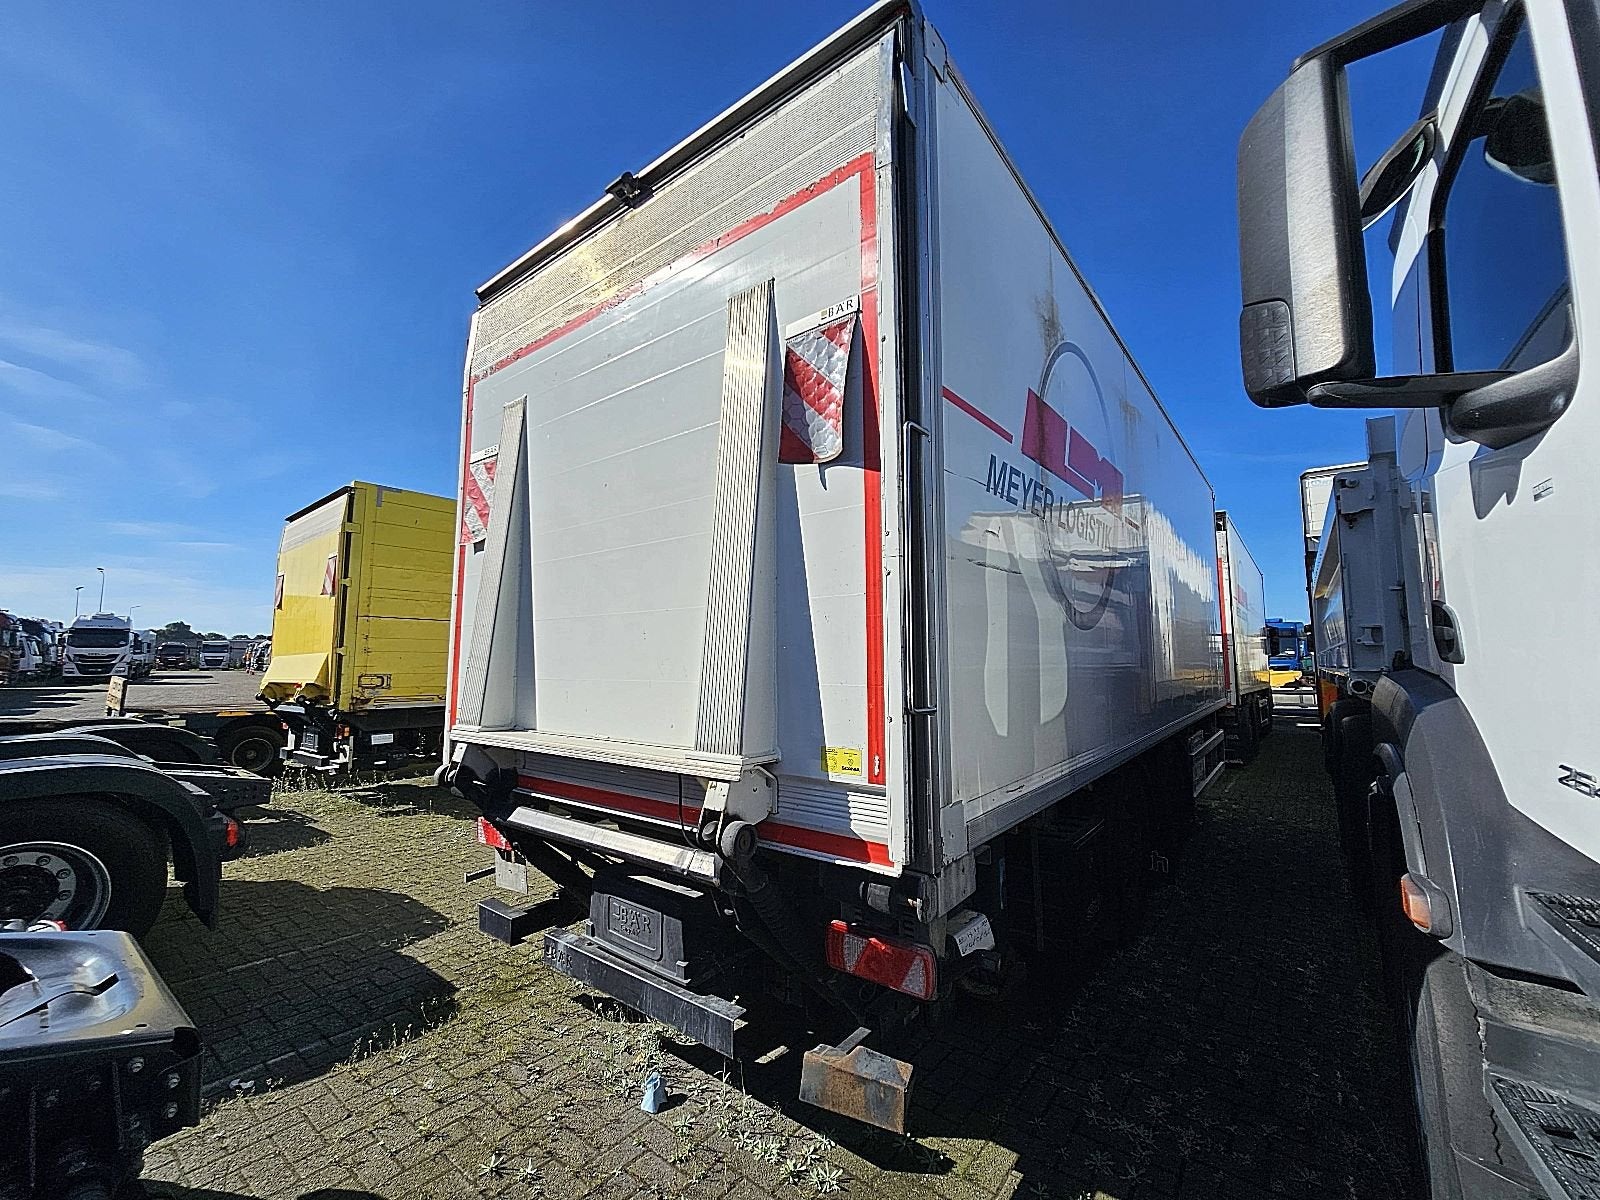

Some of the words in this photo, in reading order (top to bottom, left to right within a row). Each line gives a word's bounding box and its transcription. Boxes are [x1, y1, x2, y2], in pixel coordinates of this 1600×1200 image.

[986, 453, 1055, 524] MEYER
[1058, 496, 1112, 551] LOGISTIK
[1558, 764, 1600, 798] 25
